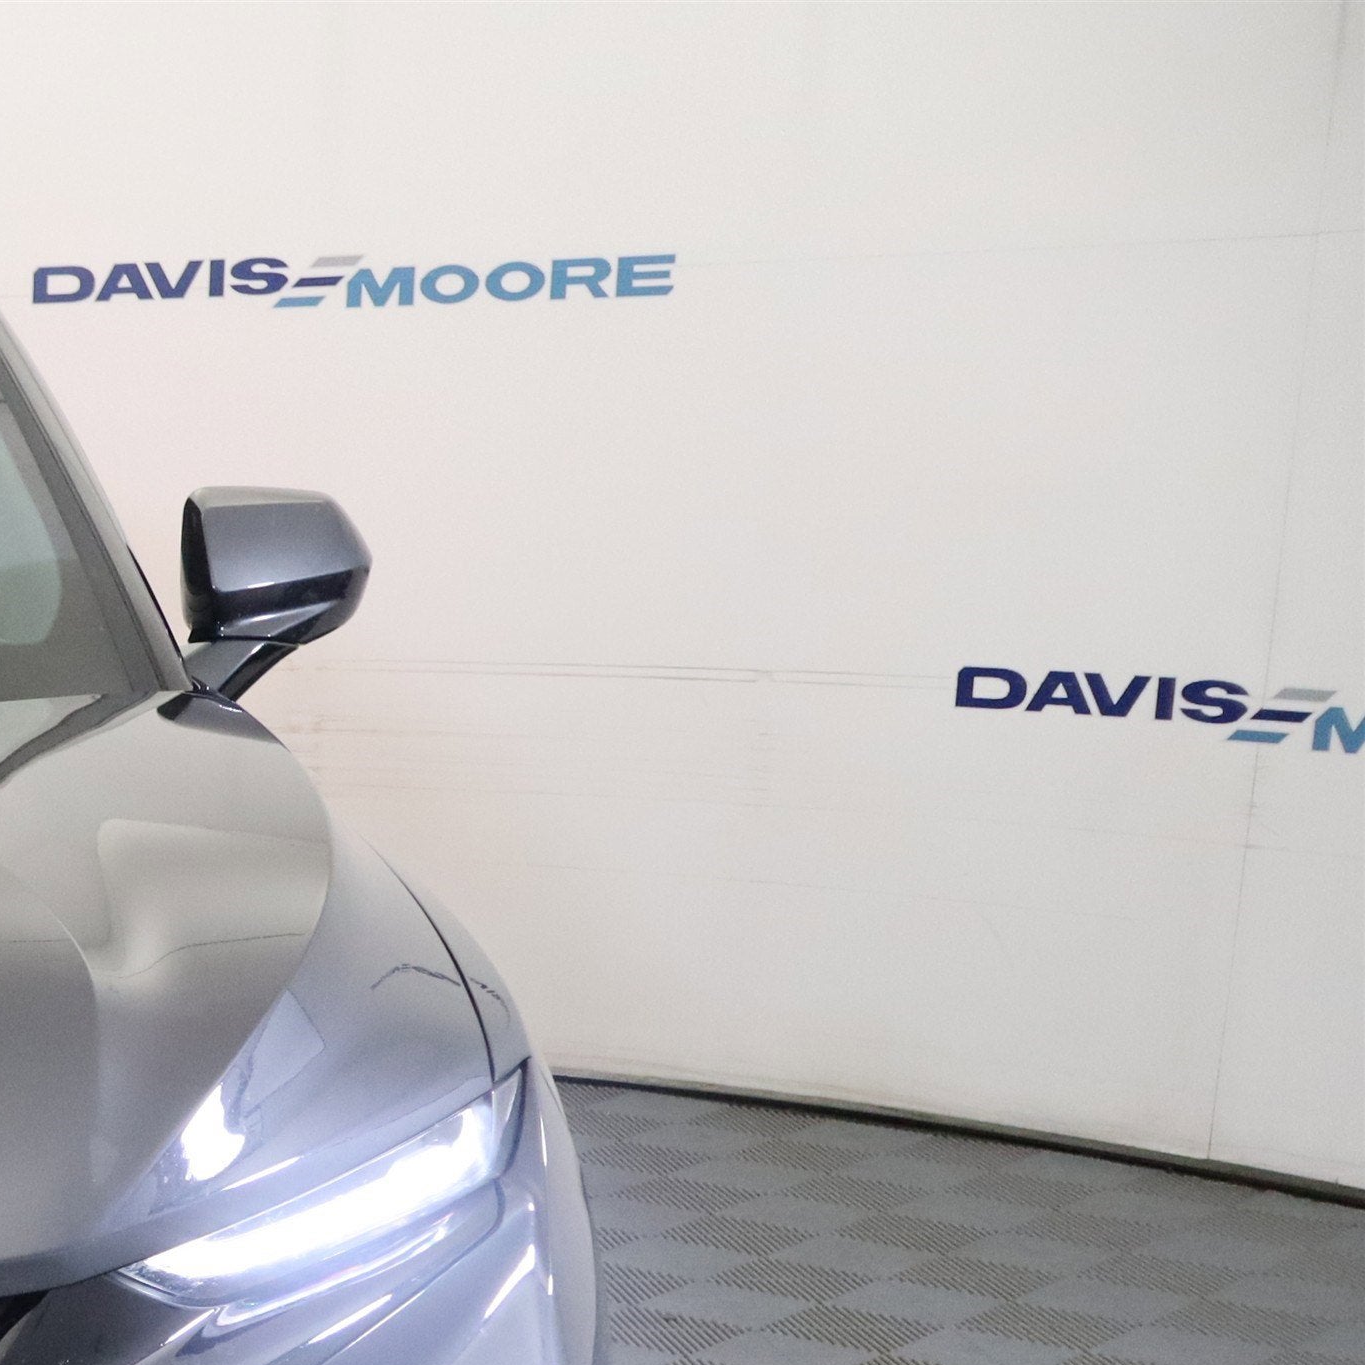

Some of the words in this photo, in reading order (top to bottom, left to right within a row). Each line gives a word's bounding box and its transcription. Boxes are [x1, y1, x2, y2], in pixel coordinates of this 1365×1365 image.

[33, 256, 290, 305] DAVIS
[346, 253, 677, 309] MOORE
[955, 666, 1251, 725] DAVIS
